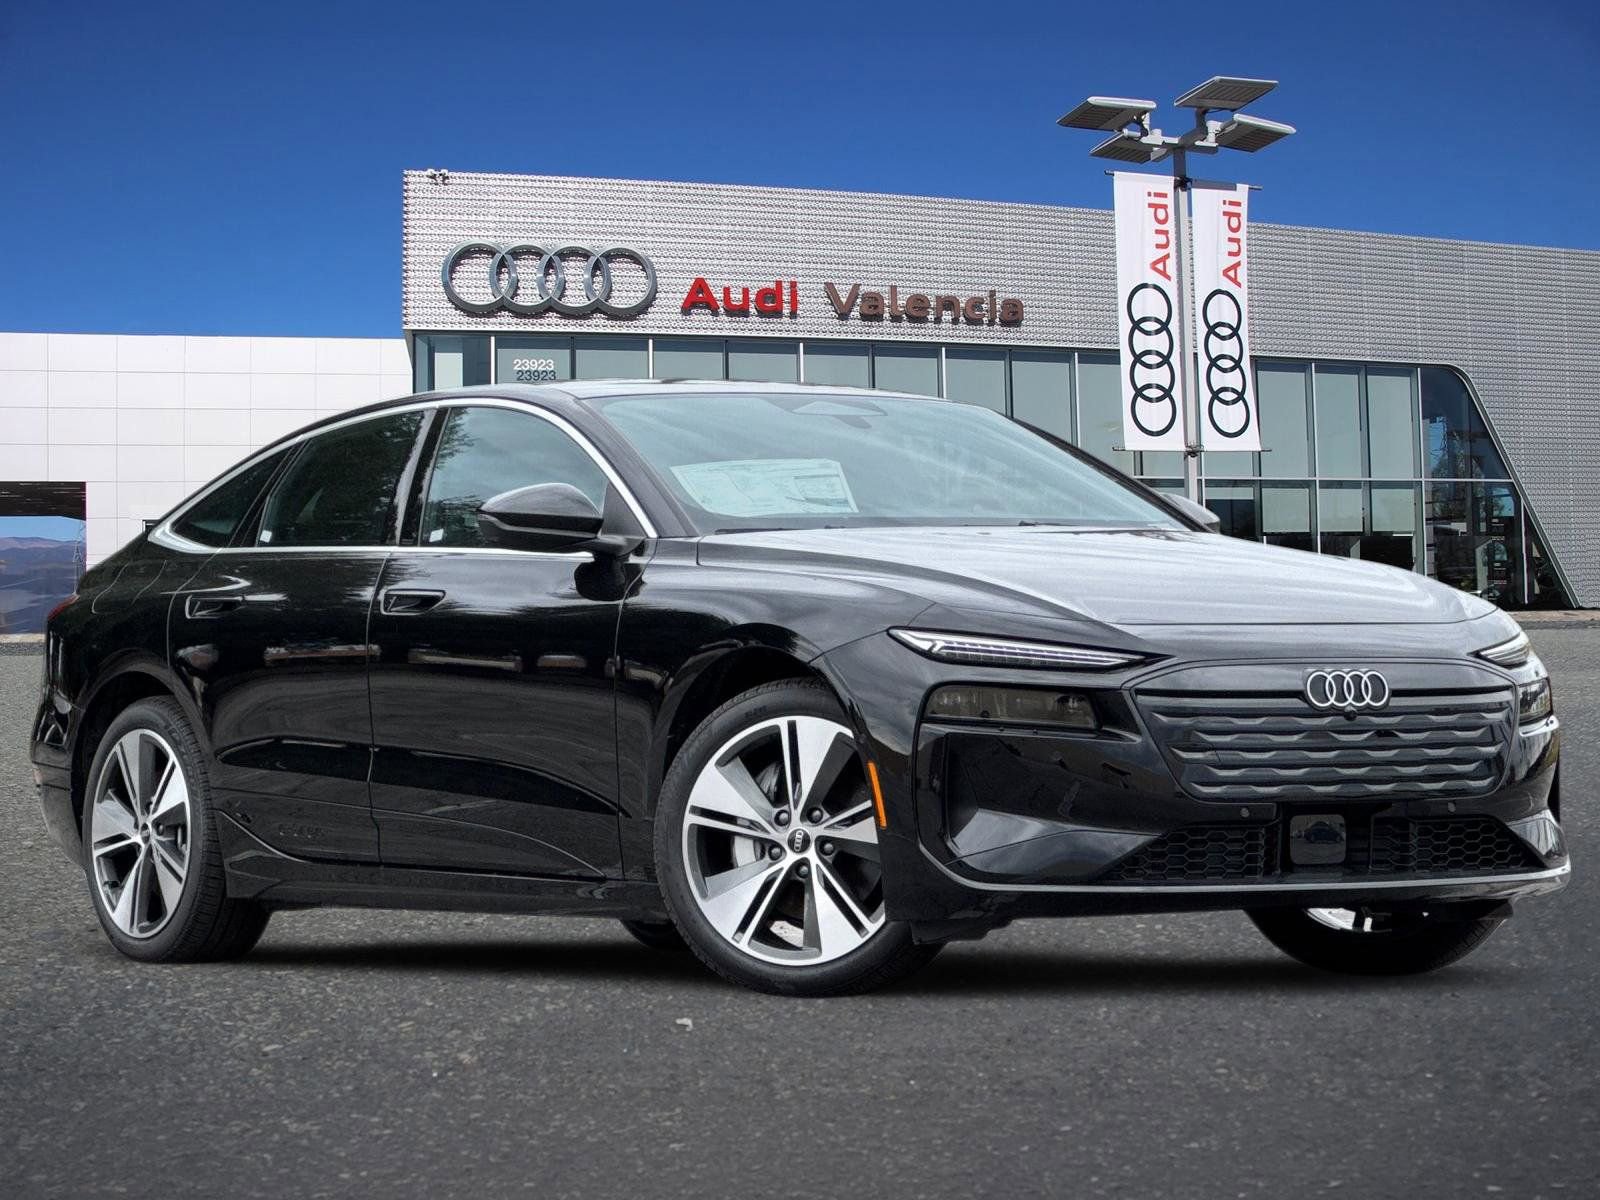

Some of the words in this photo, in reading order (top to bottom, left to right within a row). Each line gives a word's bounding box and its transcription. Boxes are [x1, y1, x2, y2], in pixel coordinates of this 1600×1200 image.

[1147, 191, 1172, 282] Audi
[1222, 199, 1242, 289] Audi
[681, 277, 798, 317] Audi
[824, 282, 1024, 326] Valencia
[513, 359, 554, 370] 23923
[516, 369, 556, 381] 23923
